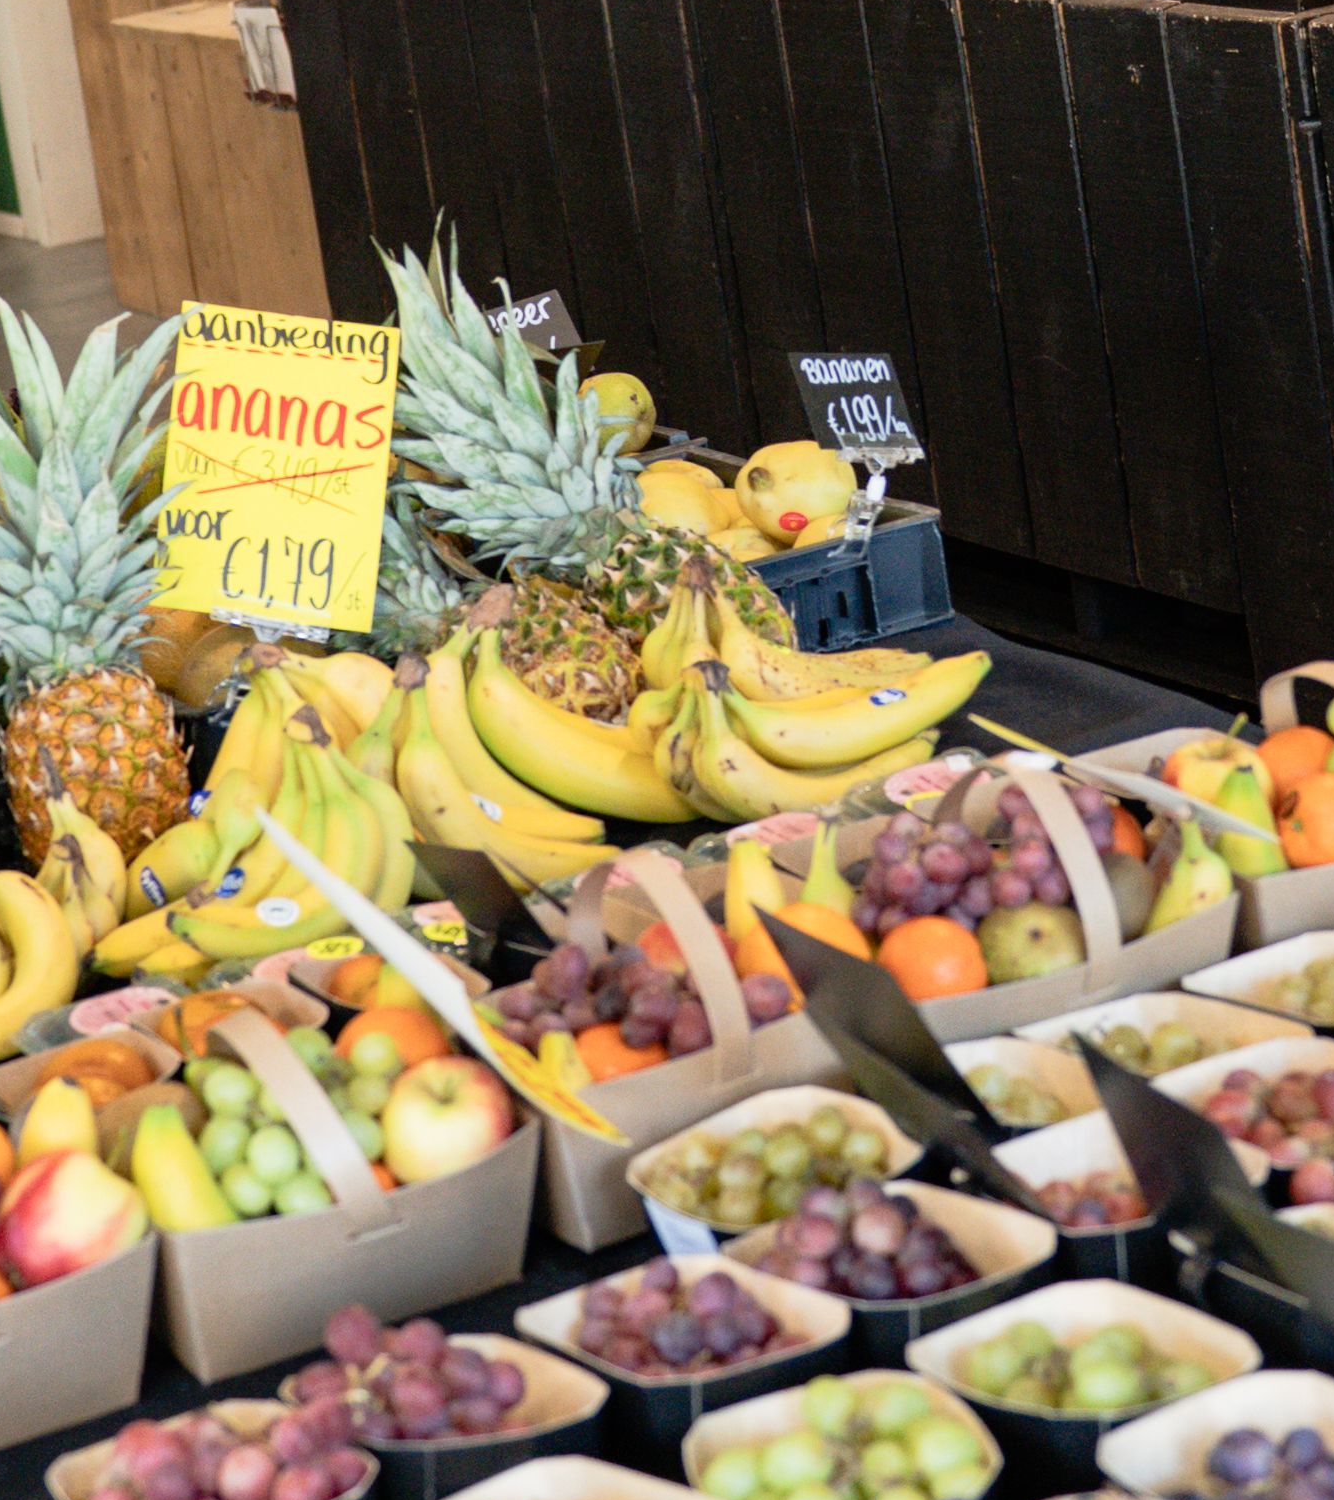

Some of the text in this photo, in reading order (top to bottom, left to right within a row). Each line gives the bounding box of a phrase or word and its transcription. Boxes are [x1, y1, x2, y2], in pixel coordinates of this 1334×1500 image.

[183, 309, 389, 385] aanbieding
[177, 381, 386, 450] ananas
[165, 509, 233, 541] voor
